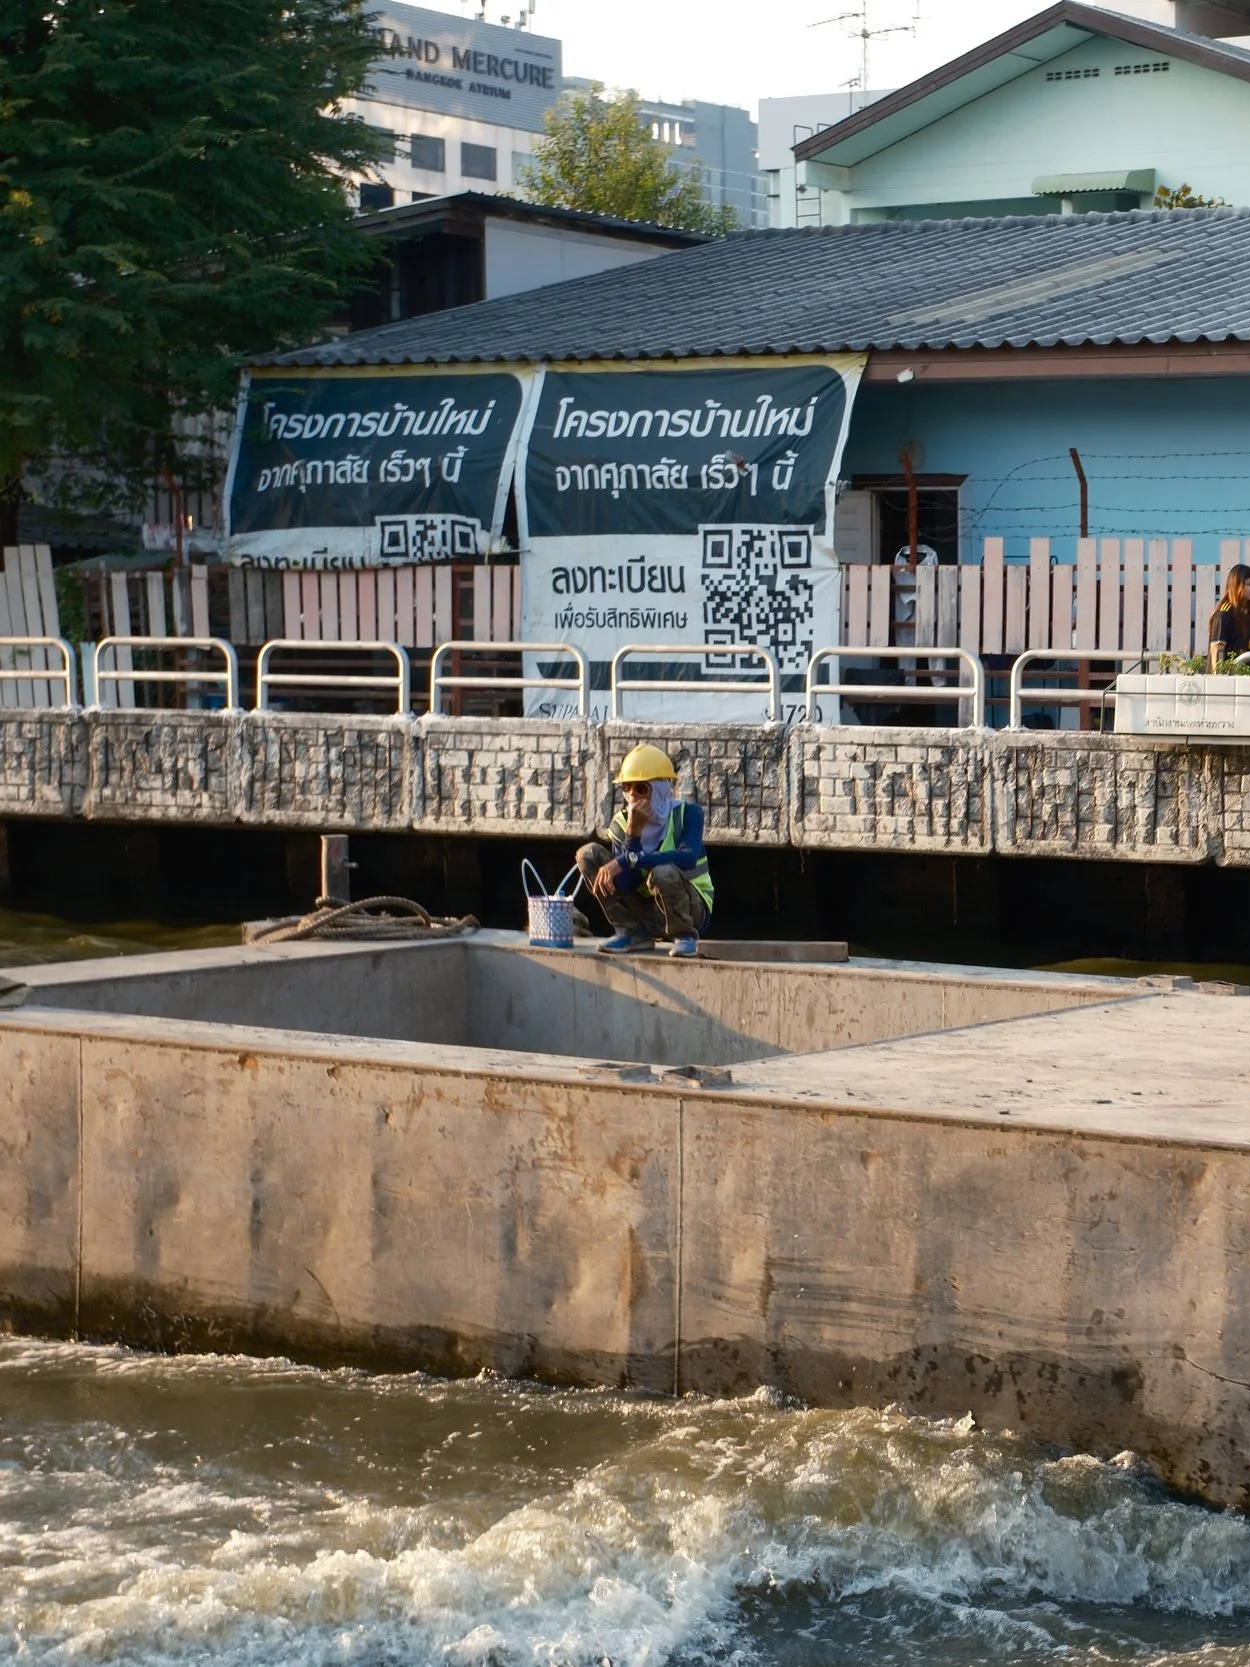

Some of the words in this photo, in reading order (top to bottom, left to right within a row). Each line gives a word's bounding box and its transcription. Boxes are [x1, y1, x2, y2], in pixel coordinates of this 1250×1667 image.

[406, 68, 463, 90] BANGKOK
[468, 81, 511, 100] ATRIUM
[452, 46, 556, 90] MERCURE
[263, 398, 497, 440] โครงการบ้านใหม่
[553, 395, 819, 438] โครงการบ้านใหม่
[257, 454, 370, 493] จากศุภาลัย
[379, 449, 432, 488] เร็วๆ
[441, 445, 469, 484] นี้
[555, 456, 689, 499] จากศุภาลัย
[701, 453, 759, 497] เร็วๆ
[771, 450, 800, 491] นี้
[551, 555, 686, 594] ลงทะเบียน
[554, 602, 689, 629] เพื่อรับสิทธิพิเศษ
[539, 703, 609, 721] SUPAAI
